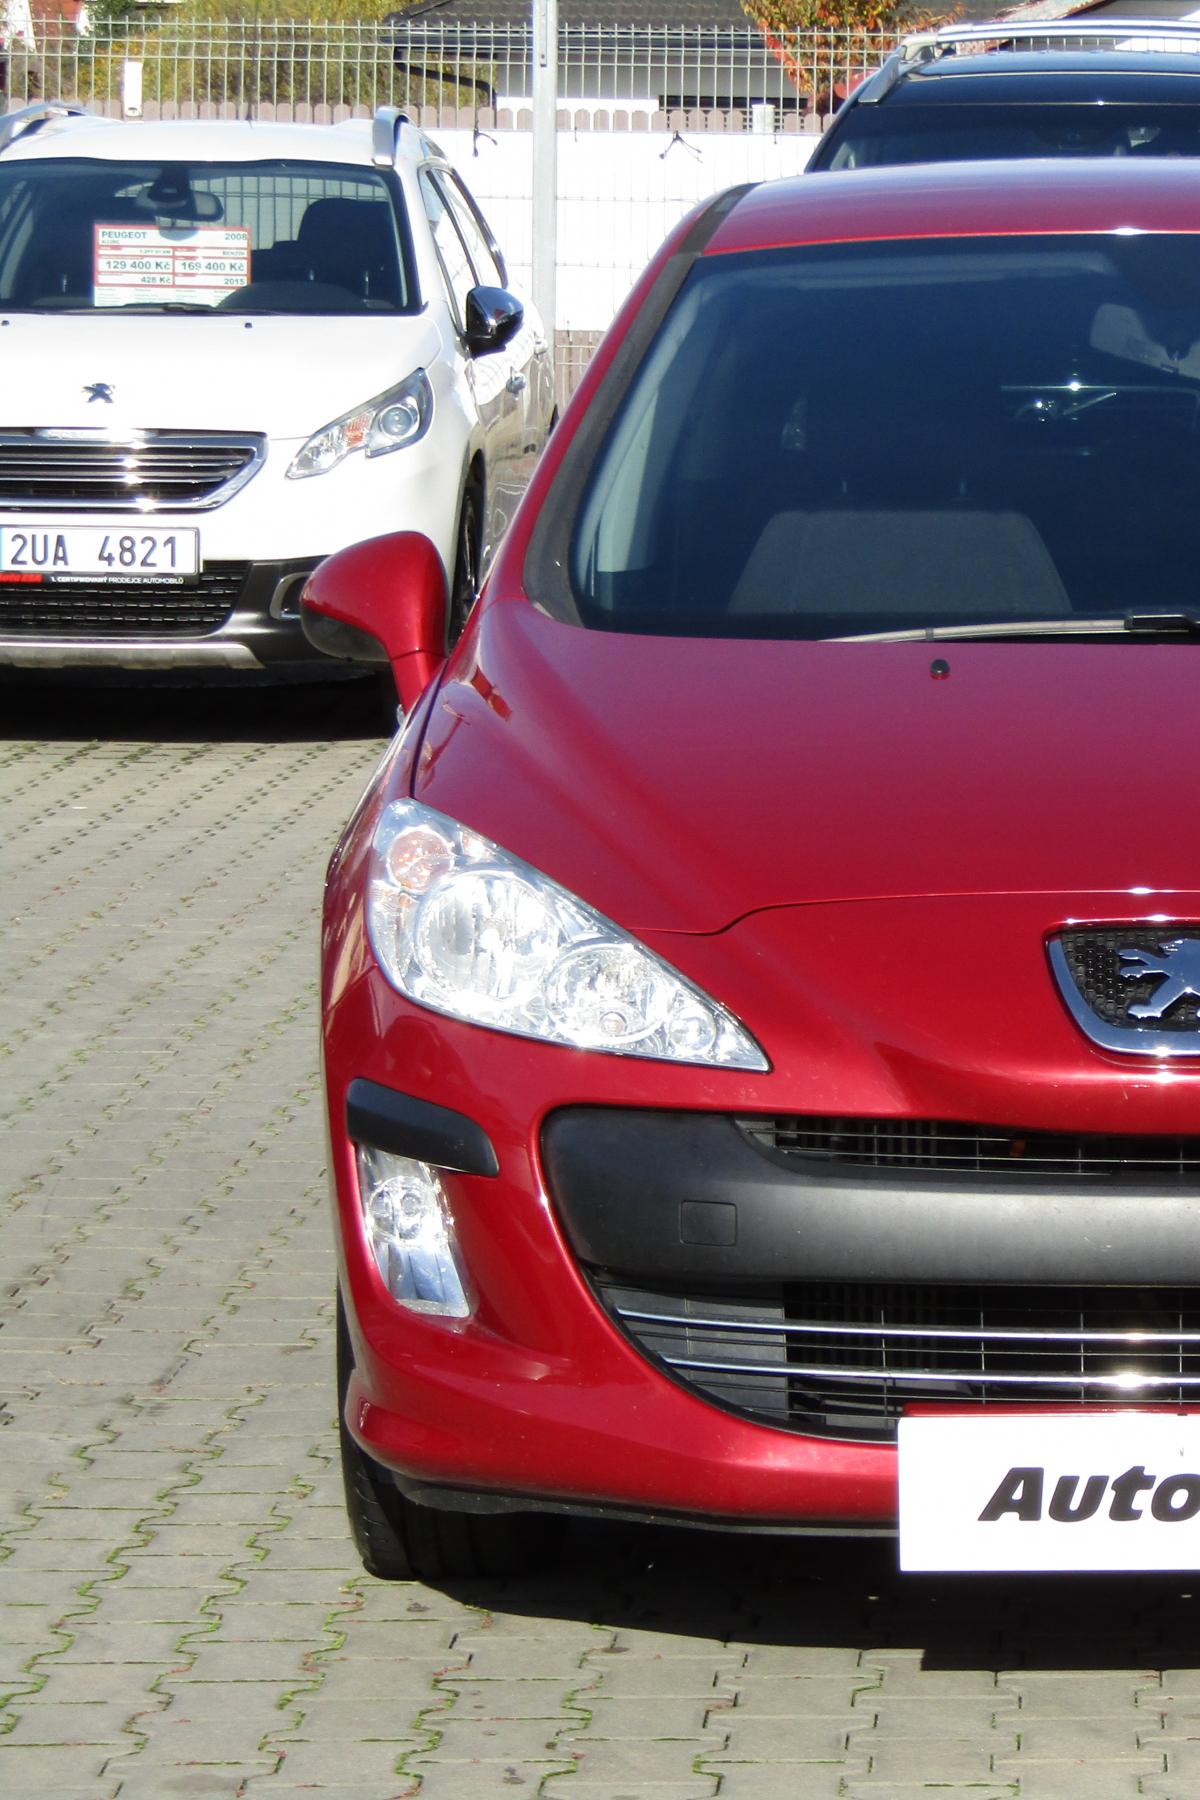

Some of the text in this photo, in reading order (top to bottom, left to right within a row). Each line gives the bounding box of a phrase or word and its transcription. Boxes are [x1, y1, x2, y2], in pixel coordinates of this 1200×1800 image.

[101, 231, 148, 239] PEUGEOT
[224, 233, 247, 241] 2008
[106, 260, 171, 270] 129 400 Kč
[181, 261, 245, 271] 169 400 Kč
[159, 276, 171, 284] Kč
[223, 278, 245, 286] 2015
[10, 534, 176, 568] 2UA 4821
[142, 576, 184, 585] AUTOMOBILŮ
